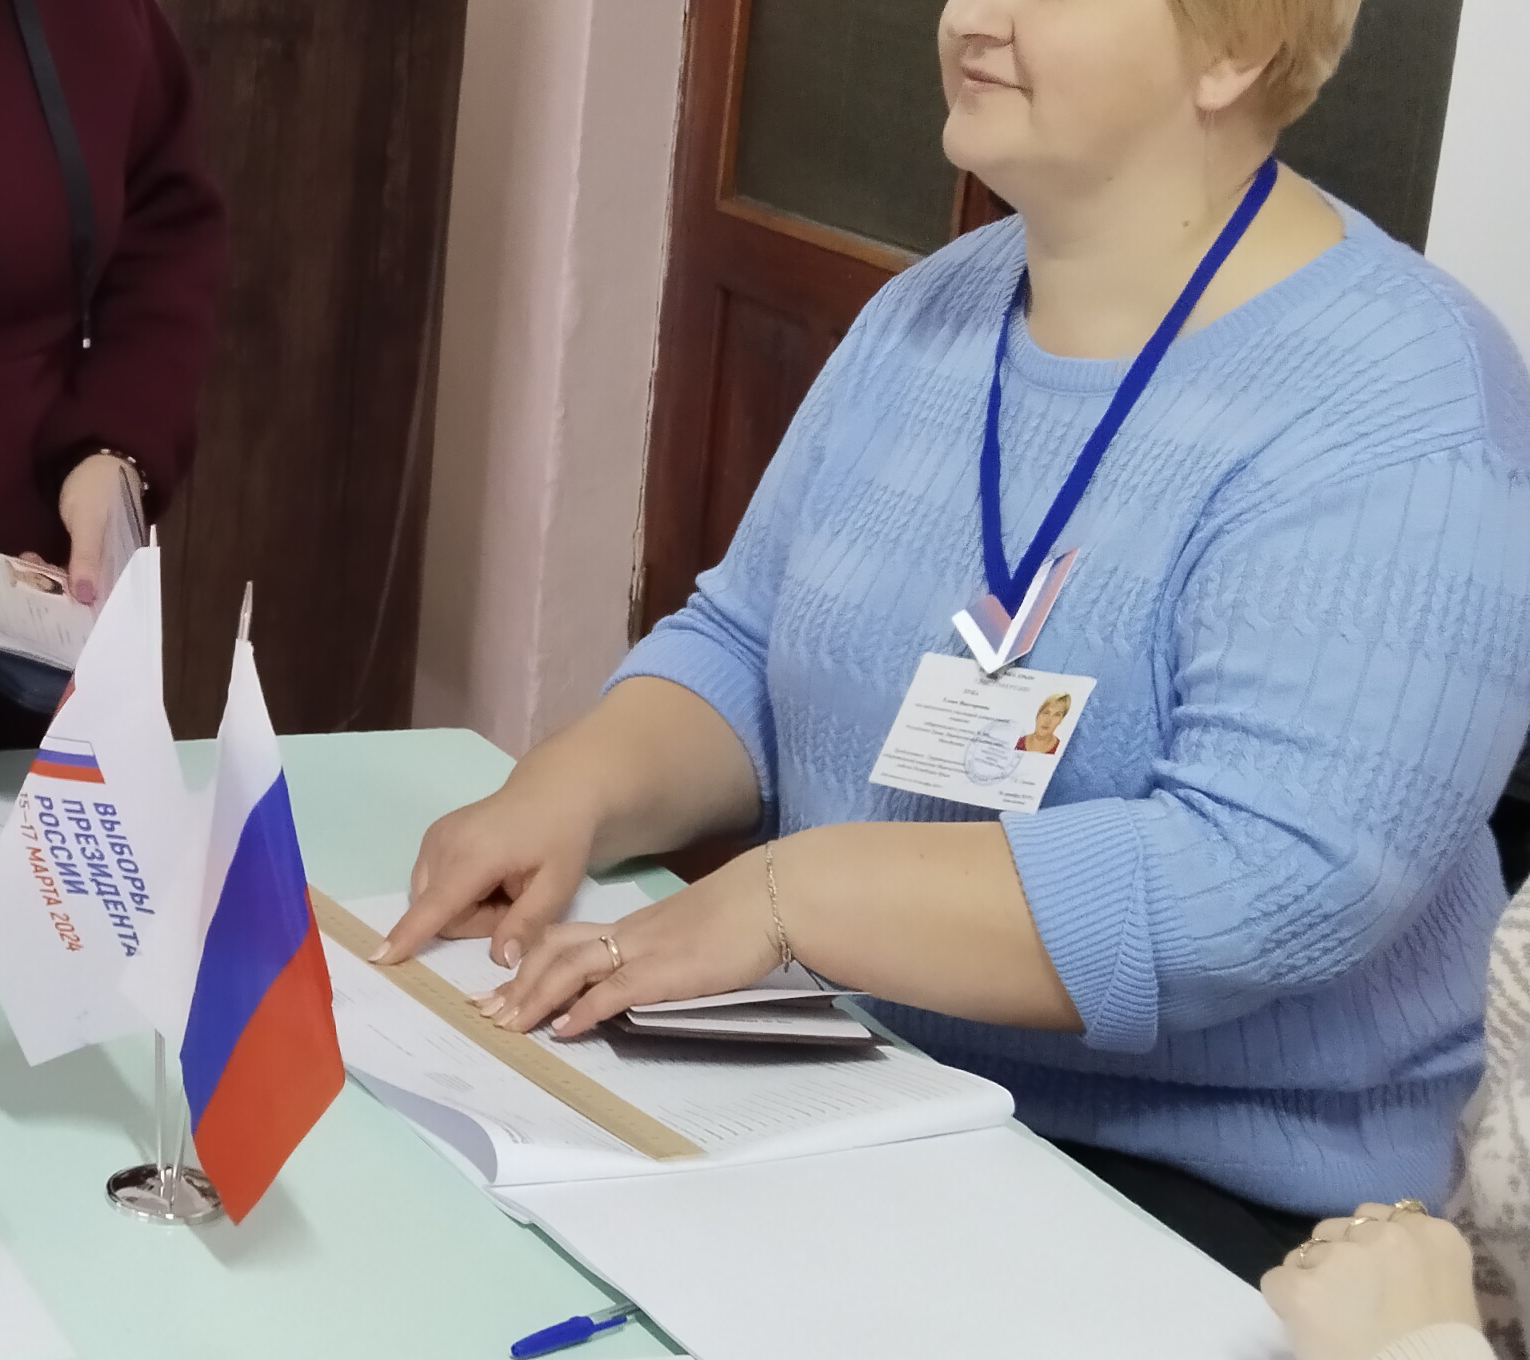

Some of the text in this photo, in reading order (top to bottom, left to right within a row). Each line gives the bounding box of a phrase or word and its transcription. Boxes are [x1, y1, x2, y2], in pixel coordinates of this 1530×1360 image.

[25, 846, 62, 907] МАРТА
[49, 911, 84, 952] 2024
[34, 794, 90, 896] РОССИИ
[62, 799, 140, 957] ПРЕЗИДЕНТА
[93, 802, 156, 915] ВЫБОРЫ
